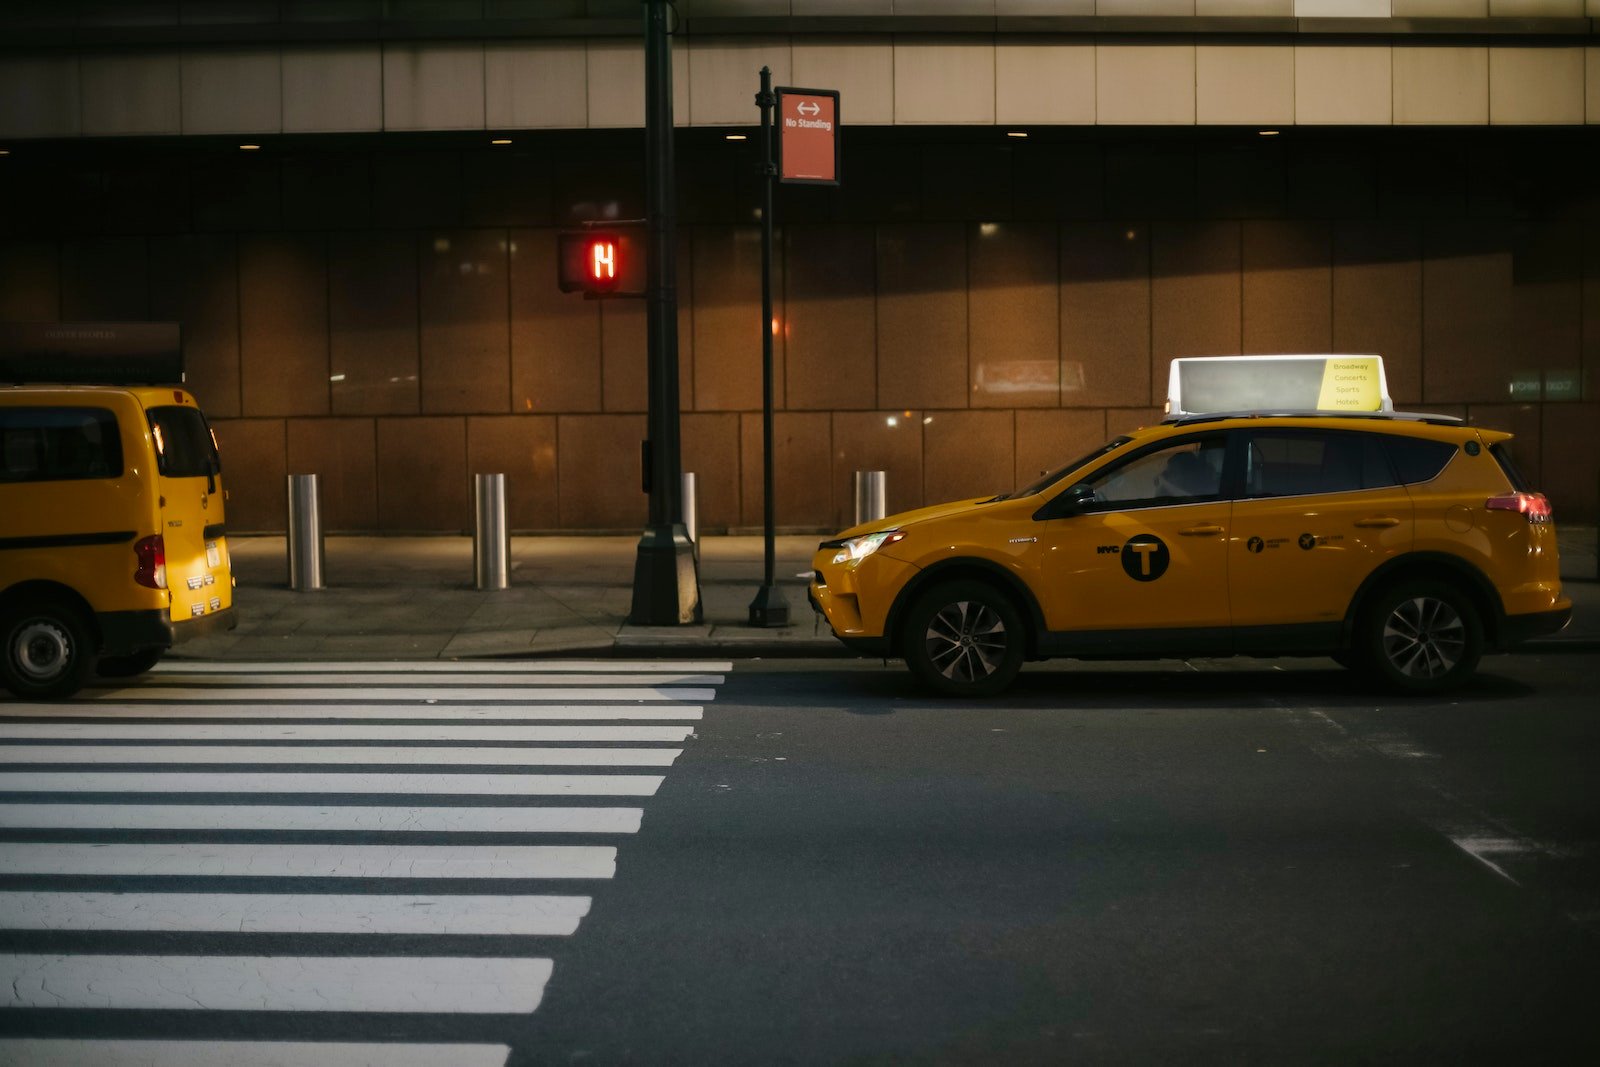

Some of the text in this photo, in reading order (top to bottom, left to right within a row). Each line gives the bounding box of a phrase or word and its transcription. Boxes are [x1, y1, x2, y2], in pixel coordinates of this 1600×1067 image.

[785, 118, 832, 131] No Standing
[1333, 363, 1369, 371] Broadway
[1335, 386, 1360, 394] Sports
[1336, 398, 1360, 406] Hotels
[1096, 542, 1159, 576] NYC T
